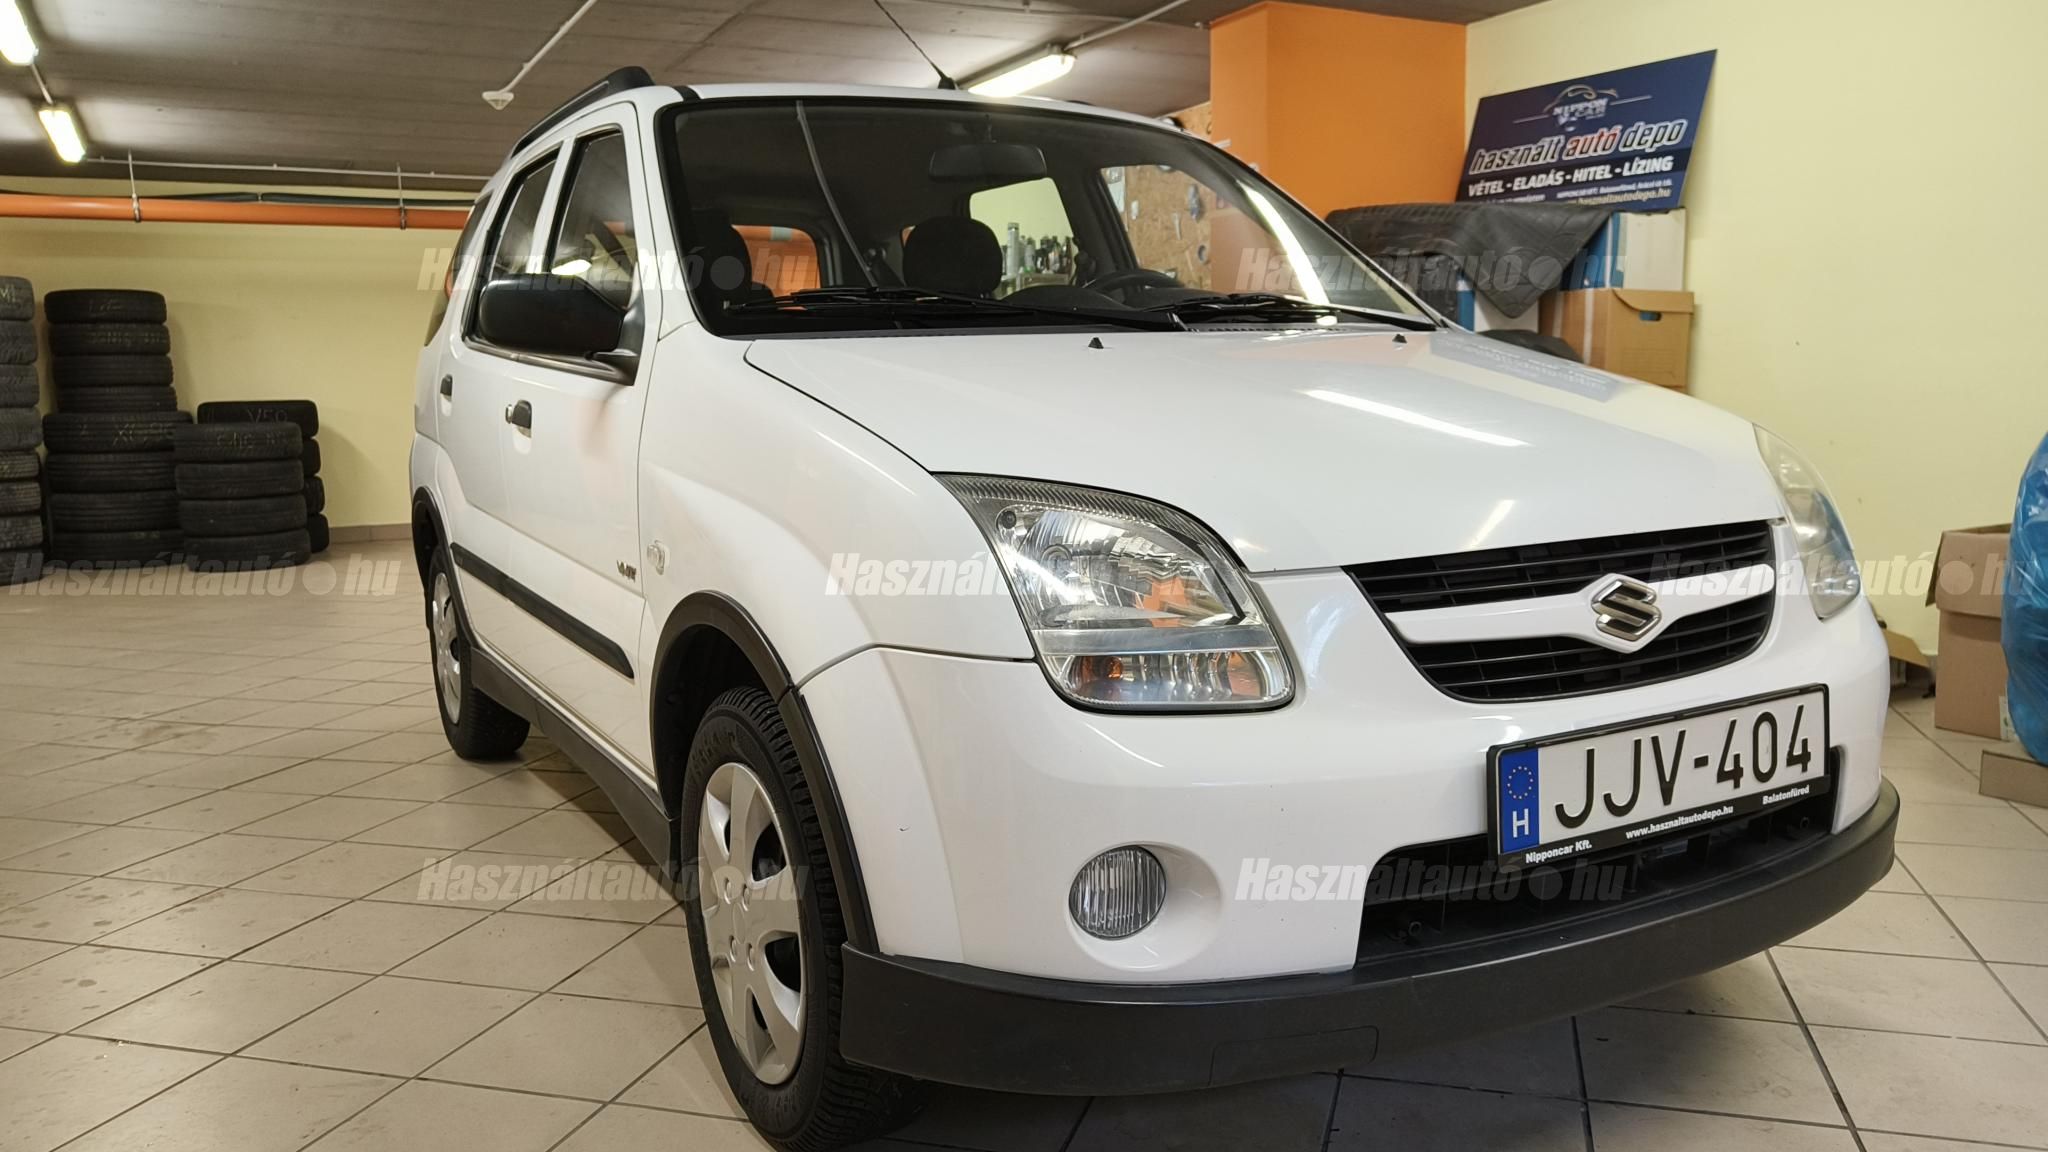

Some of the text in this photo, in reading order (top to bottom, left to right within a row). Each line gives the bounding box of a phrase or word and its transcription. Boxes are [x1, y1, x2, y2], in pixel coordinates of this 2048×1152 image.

[1469, 119, 1688, 175] használt autó depo
[1468, 156, 1674, 197] VÉTEL ELADÁS HITEL LÍZING
[1555, 704, 1812, 829] JJV-404
[1762, 784, 1810, 805] Balatonfüred
[1512, 808, 1529, 838] H
[1625, 804, 1734, 840] www.hasznaltautodepo.hu
[1525, 839, 1593, 864] Nipponcar Kft.
